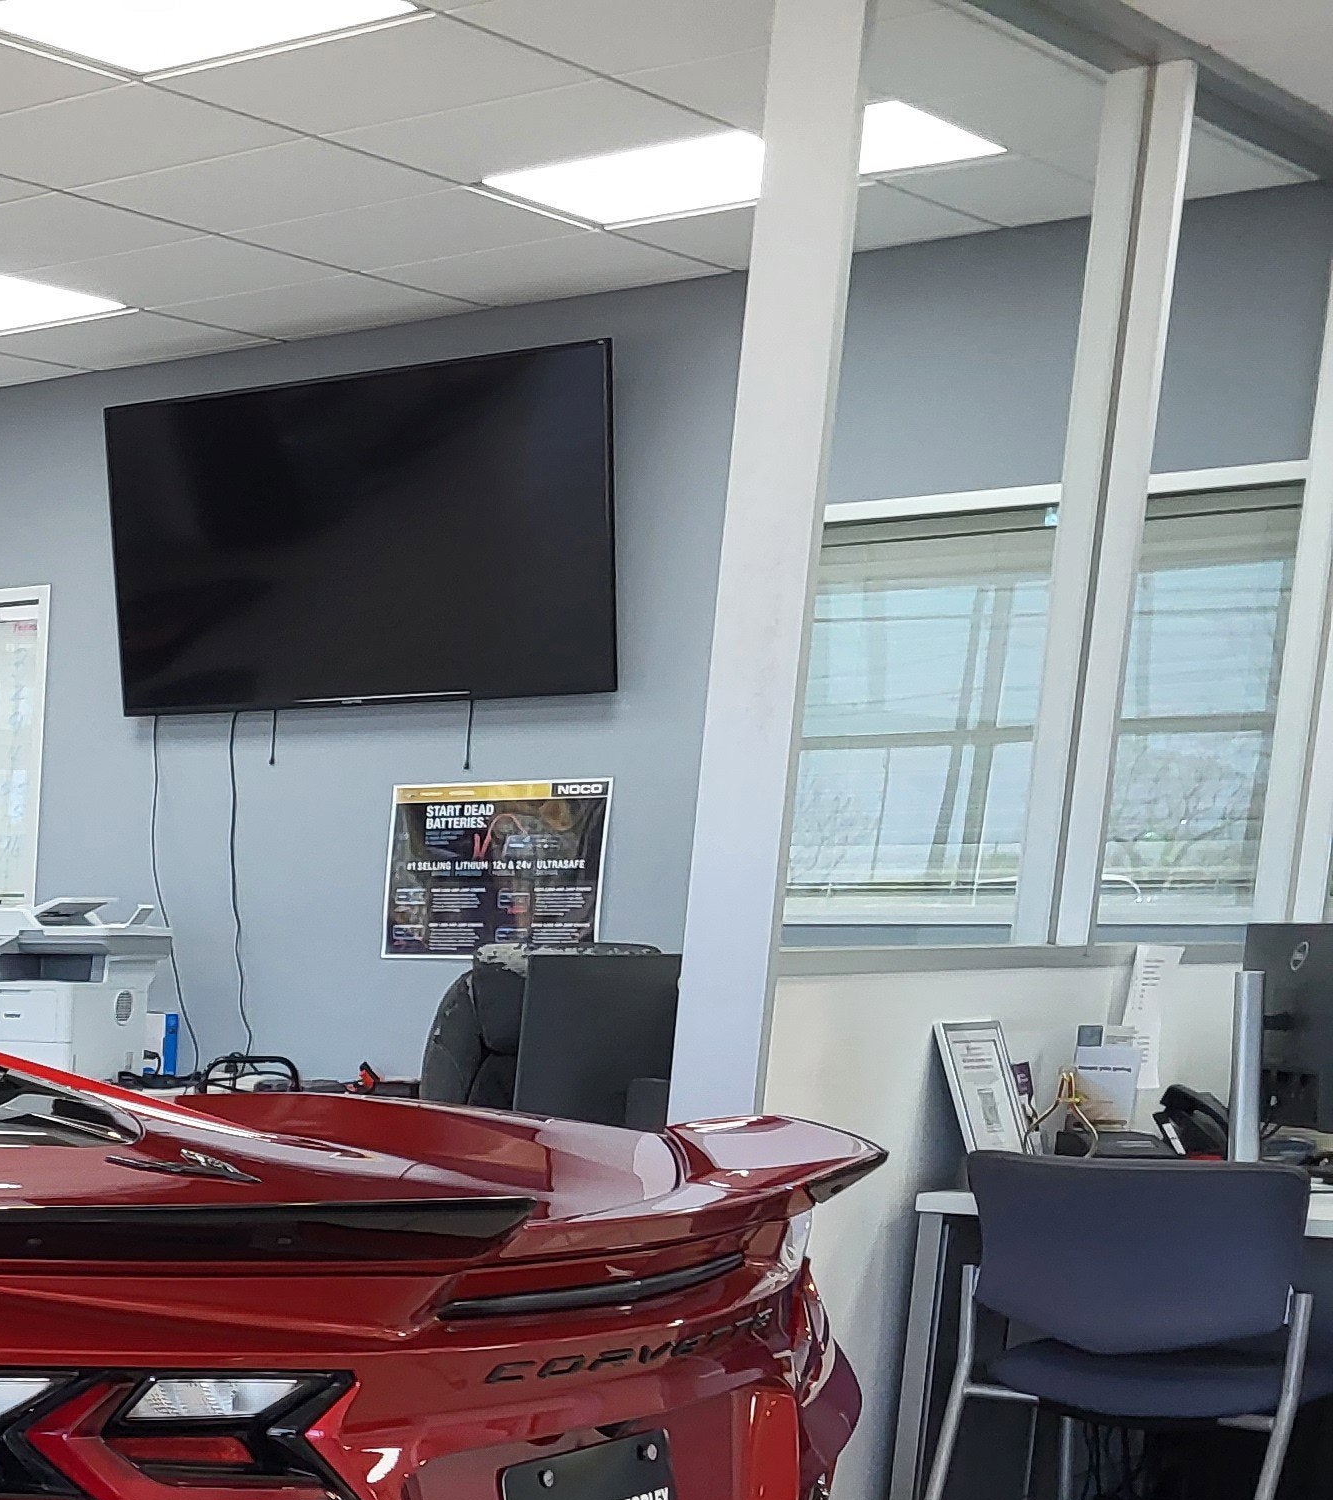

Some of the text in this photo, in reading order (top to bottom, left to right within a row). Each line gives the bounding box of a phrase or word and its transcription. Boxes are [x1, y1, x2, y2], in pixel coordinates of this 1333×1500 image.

[557, 784, 604, 796] NOCO
[425, 803, 495, 817] START DEAD
[425, 816, 488, 830] BATTERIES.
[417, 861, 452, 871] SELLING
[455, 860, 489, 871] LITHIUM
[507, 860, 515, 870] &
[536, 859, 586, 870] ULTRASAFE
